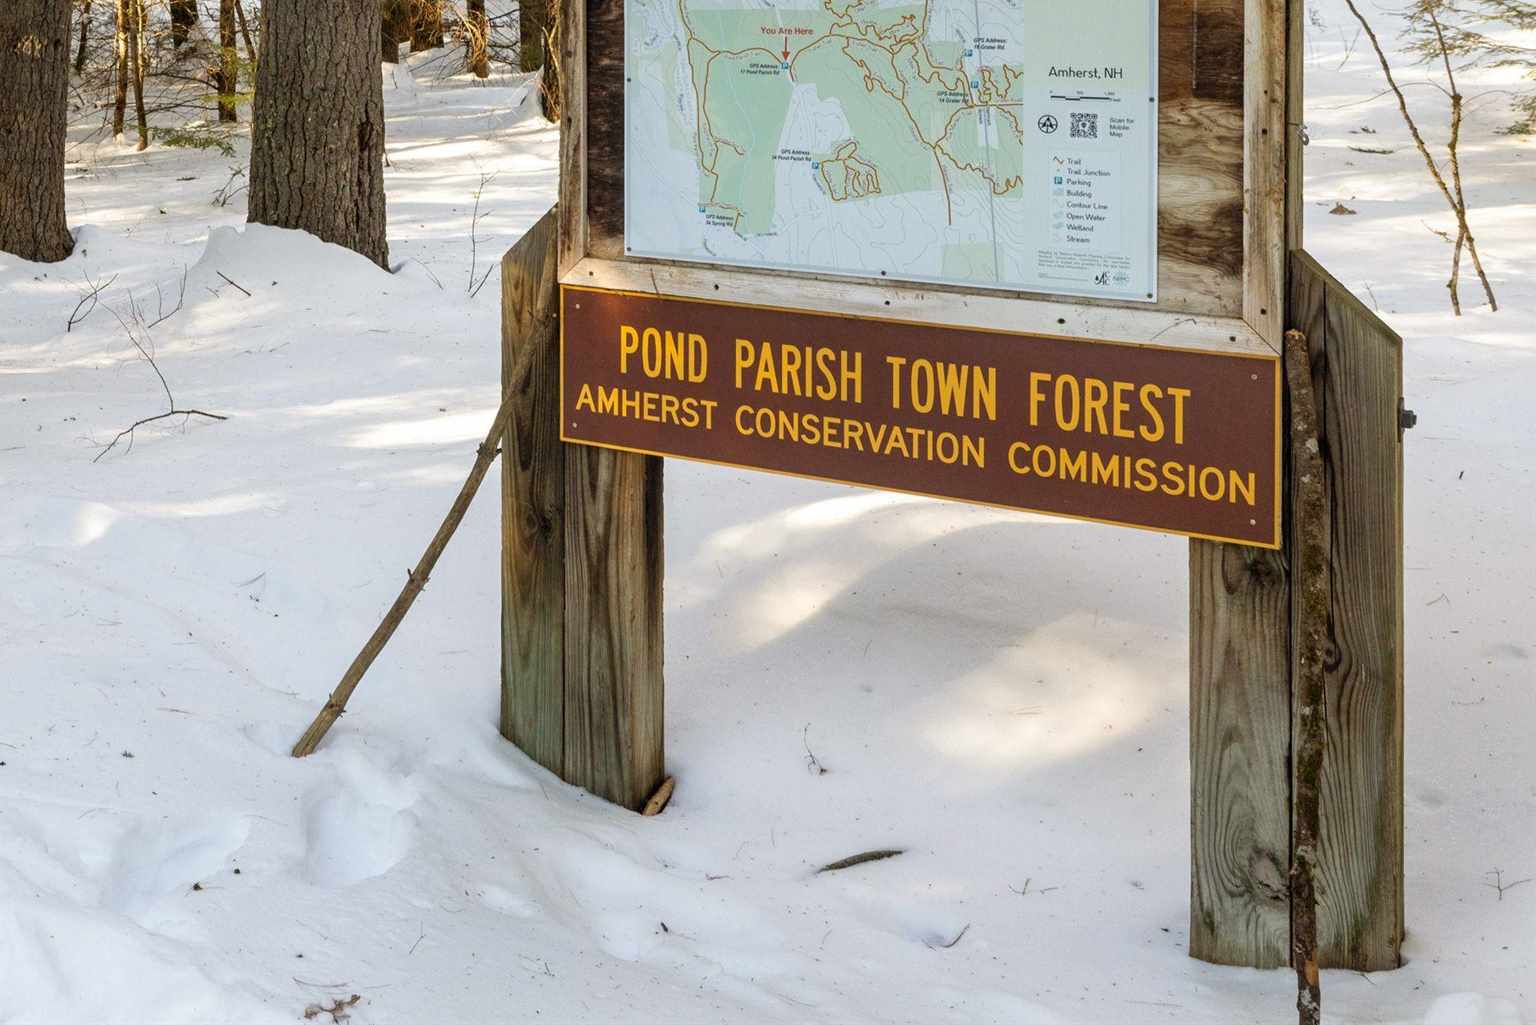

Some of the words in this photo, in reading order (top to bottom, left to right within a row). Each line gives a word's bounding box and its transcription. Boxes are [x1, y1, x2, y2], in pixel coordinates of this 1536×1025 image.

[761, 26, 776, 35] You
[778, 26, 793, 35] Are
[794, 27, 814, 35] Here
[1048, 66, 1101, 80] Amherst,
[1104, 67, 1123, 79] NH
[1066, 158, 1082, 166] Trail
[1067, 168, 1082, 176] Trail
[1066, 178, 1092, 188] Parking
[1066, 190, 1092, 198] Building
[1066, 213, 1084, 222] Open
[1085, 214, 1106, 222] Water
[1066, 224, 1094, 232] Wetland
[1066, 236, 1090, 244] Stream
[620, 324, 708, 385] POND
[735, 338, 863, 405] PARISH
[886, 355, 998, 421] TOWN
[1029, 371, 1192, 446] FOREST
[575, 384, 718, 431] AMHERST
[735, 405, 986, 469] CONSERVATION
[1007, 441, 1256, 507] COMMISSION
